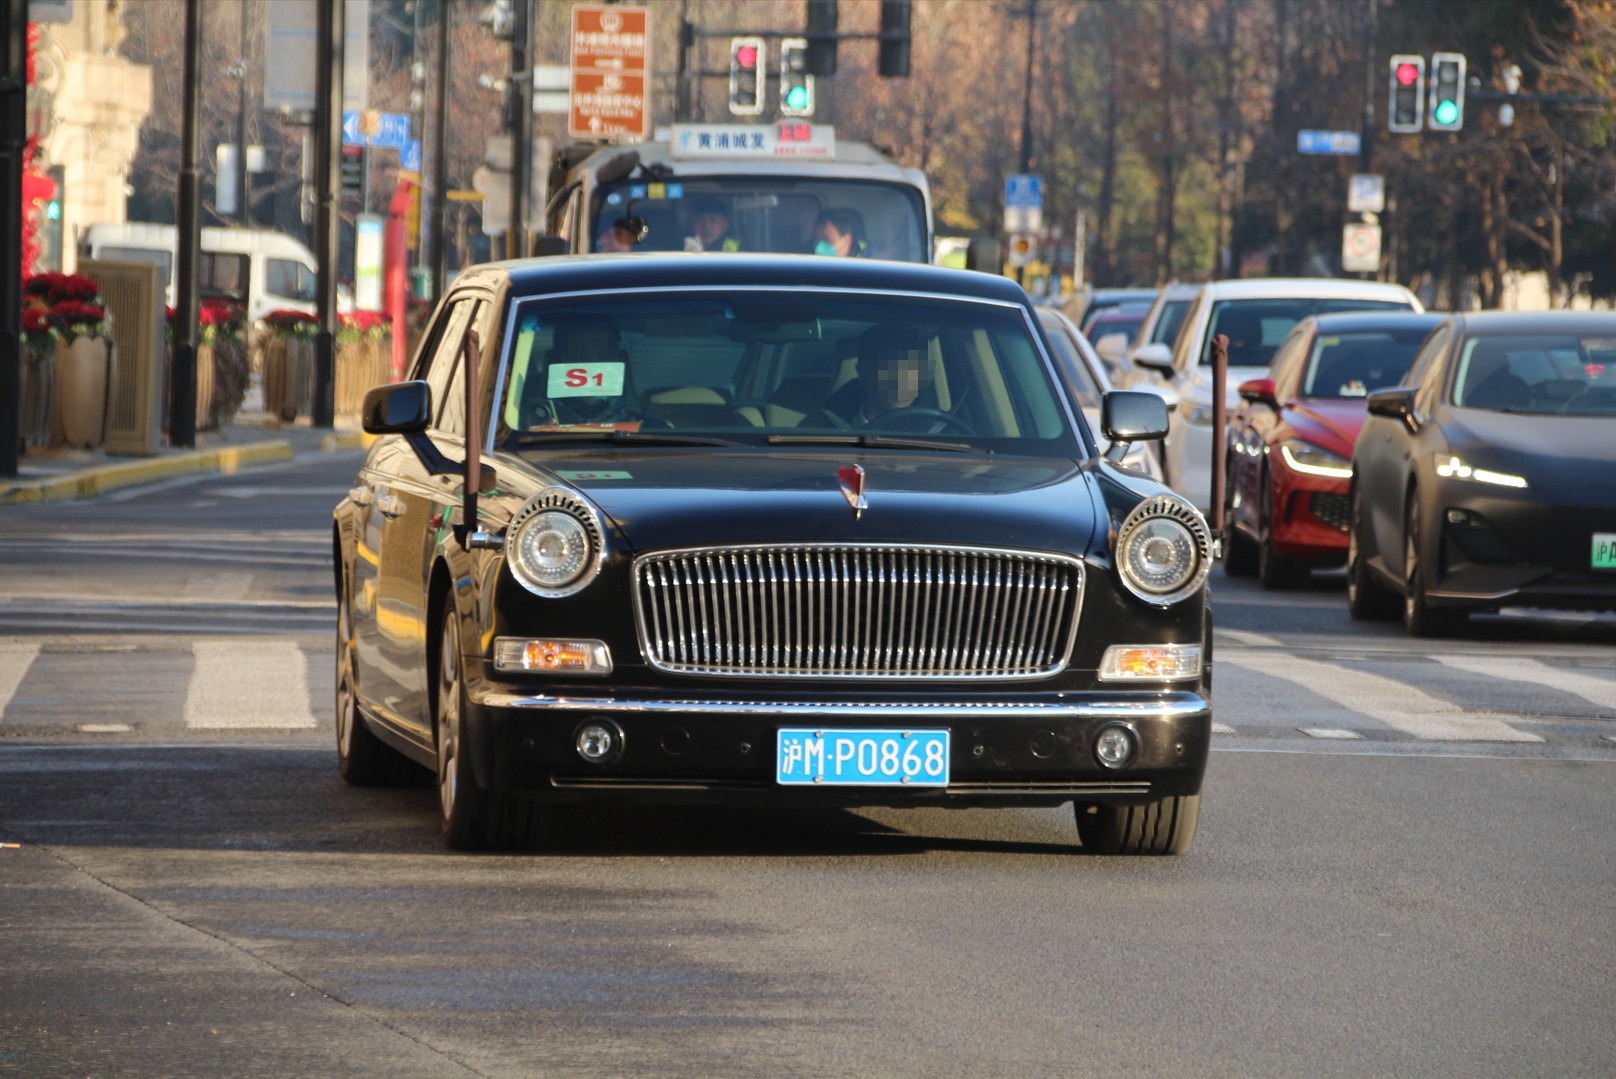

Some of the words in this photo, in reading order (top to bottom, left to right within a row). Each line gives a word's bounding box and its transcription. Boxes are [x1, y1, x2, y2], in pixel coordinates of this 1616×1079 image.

[698, 132, 764, 149] 黄浦城发
[564, 368, 604, 388] S1
[782, 738, 944, 776] 沪M·P0868
